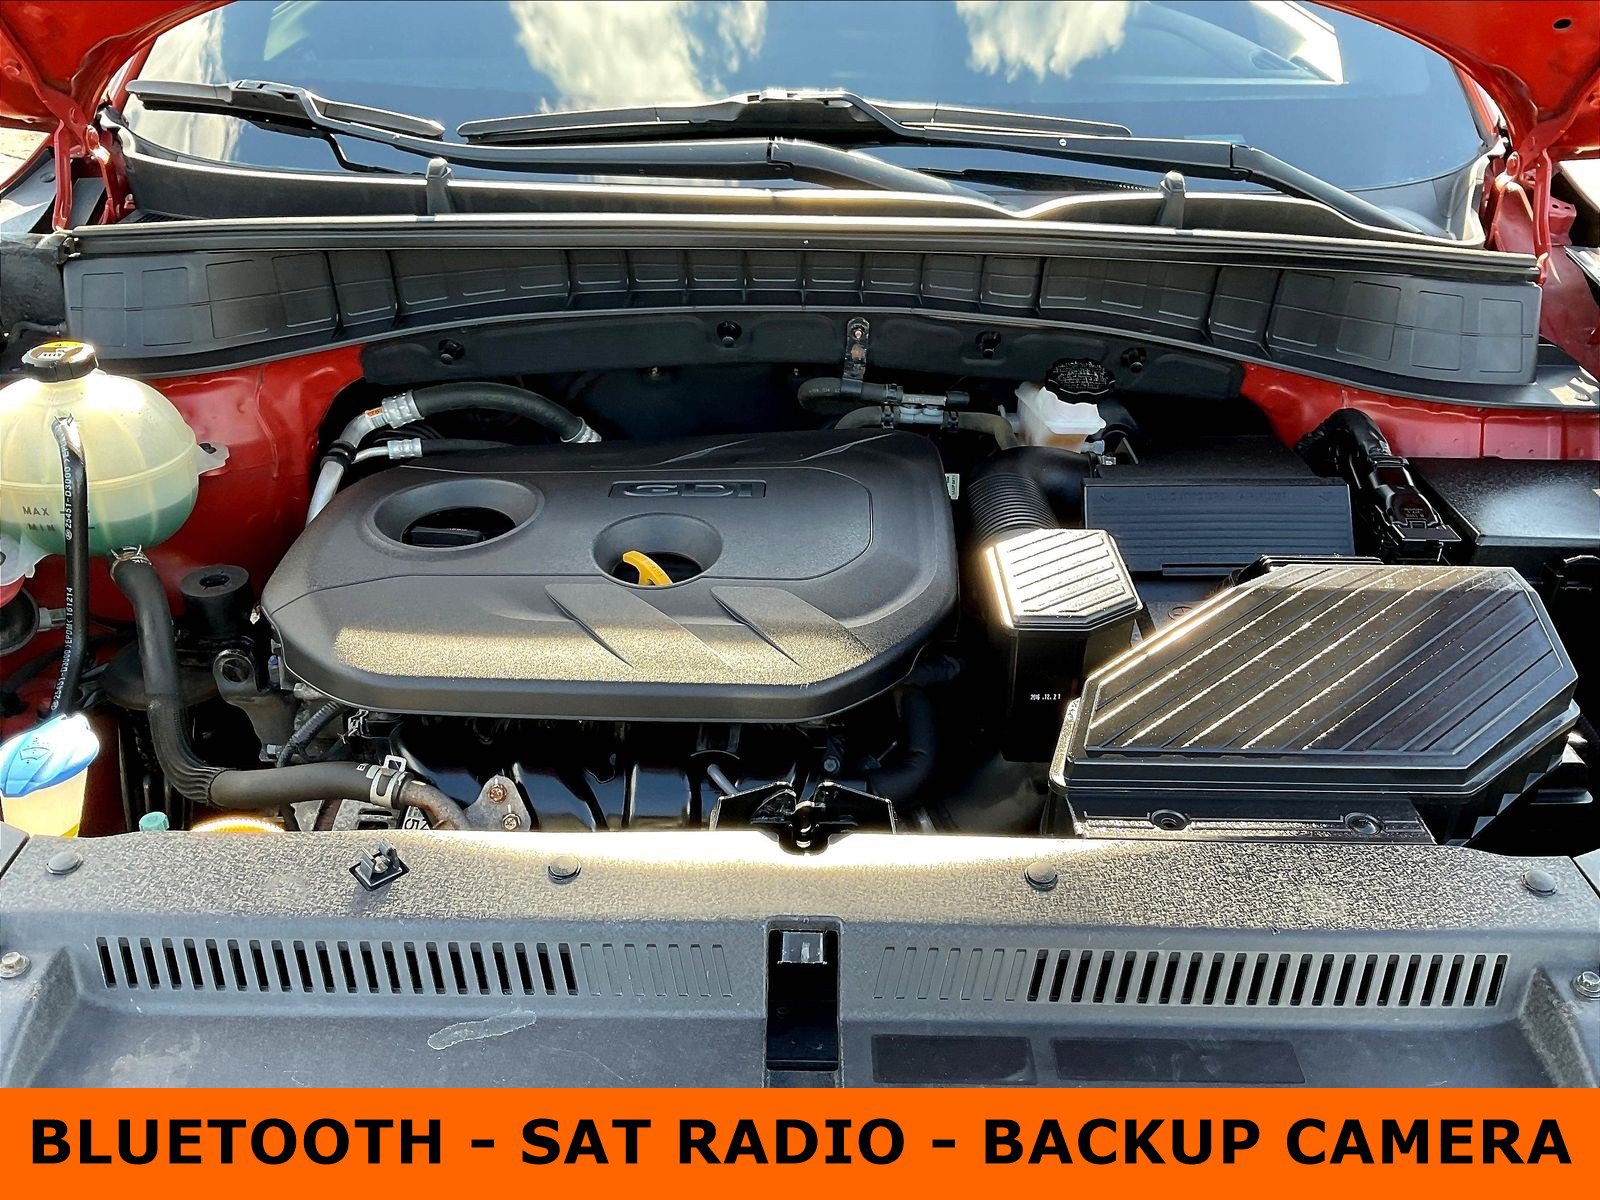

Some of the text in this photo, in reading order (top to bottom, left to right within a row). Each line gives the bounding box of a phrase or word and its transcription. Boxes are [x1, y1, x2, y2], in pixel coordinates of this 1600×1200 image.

[624, 484, 753, 497] GDI
[22, 506, 49, 516] MAX
[28, 523, 55, 532] MIN
